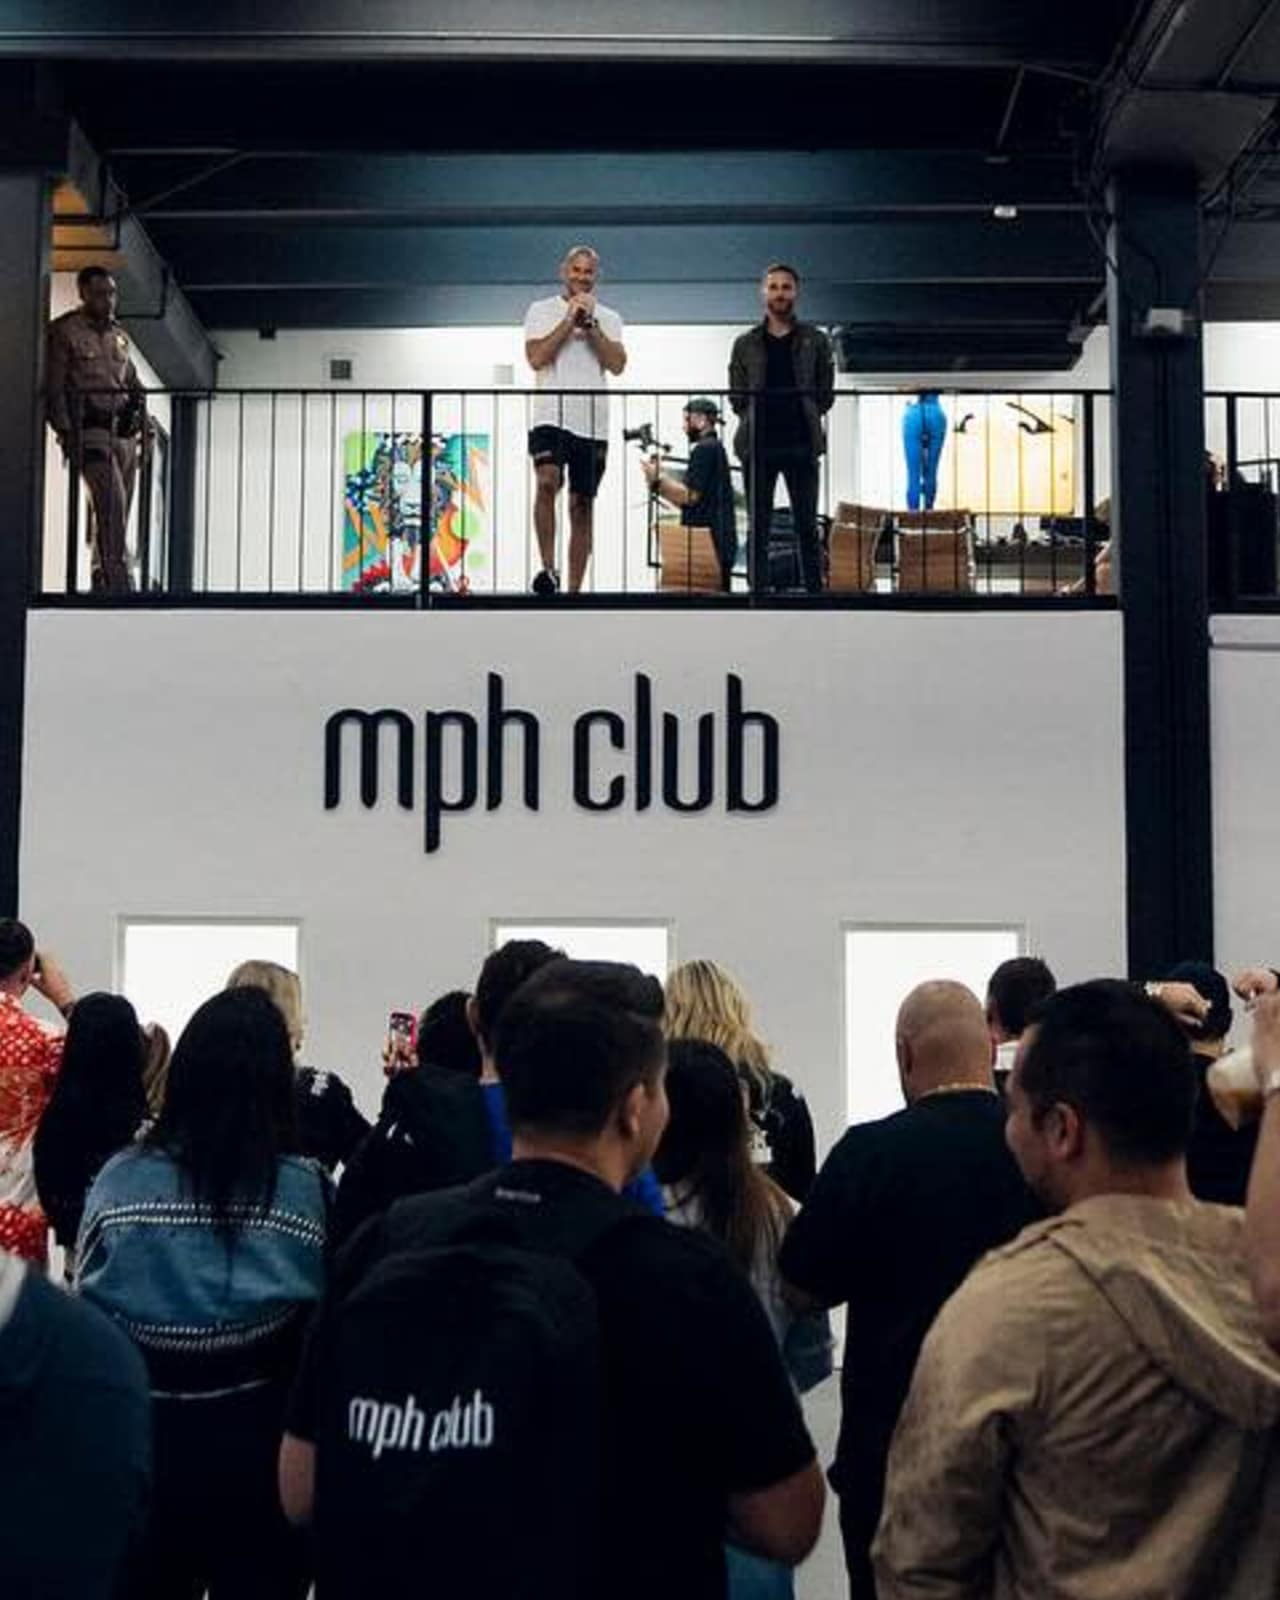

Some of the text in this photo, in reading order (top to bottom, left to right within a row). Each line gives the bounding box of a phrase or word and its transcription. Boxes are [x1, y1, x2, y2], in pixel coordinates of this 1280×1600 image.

[324, 671, 780, 854] mph club
[348, 1387, 495, 1460] mph club
